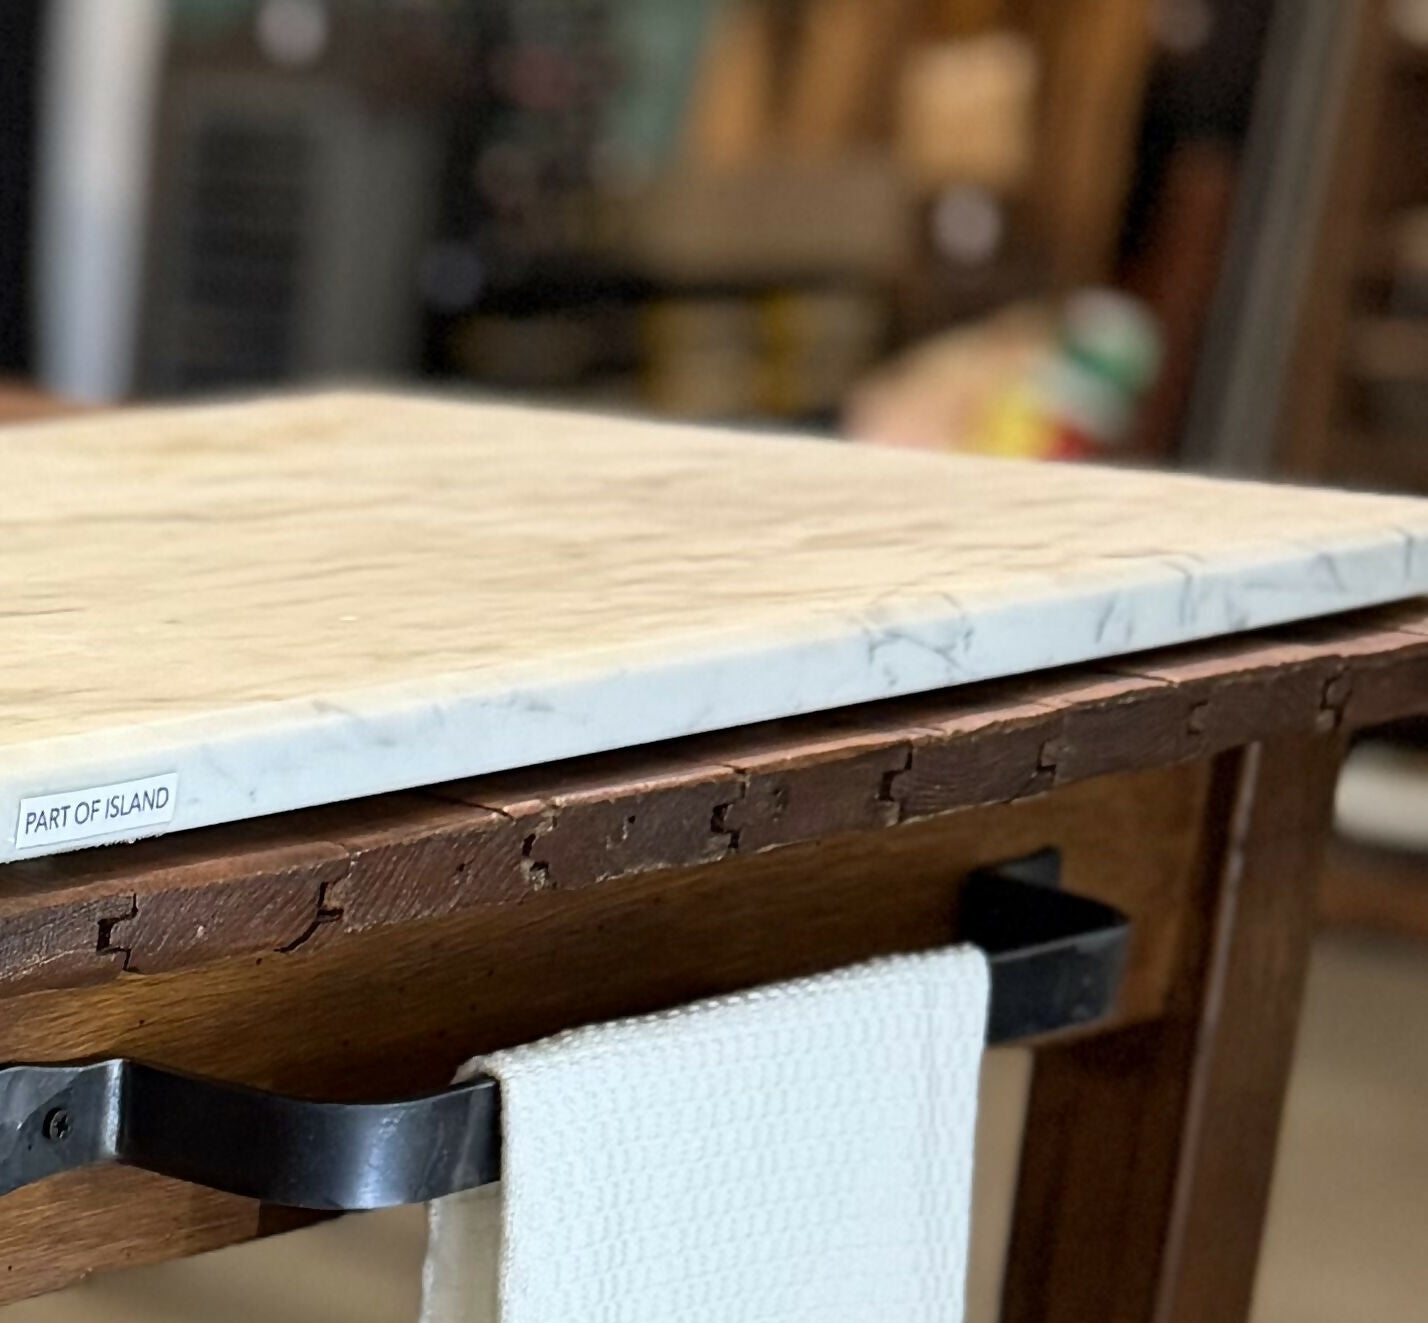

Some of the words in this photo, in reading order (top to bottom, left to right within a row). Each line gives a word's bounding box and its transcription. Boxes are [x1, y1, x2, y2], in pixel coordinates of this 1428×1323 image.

[25, 804, 71, 835] PART
[74, 799, 102, 825] OF
[104, 786, 170, 820] ISLAND
